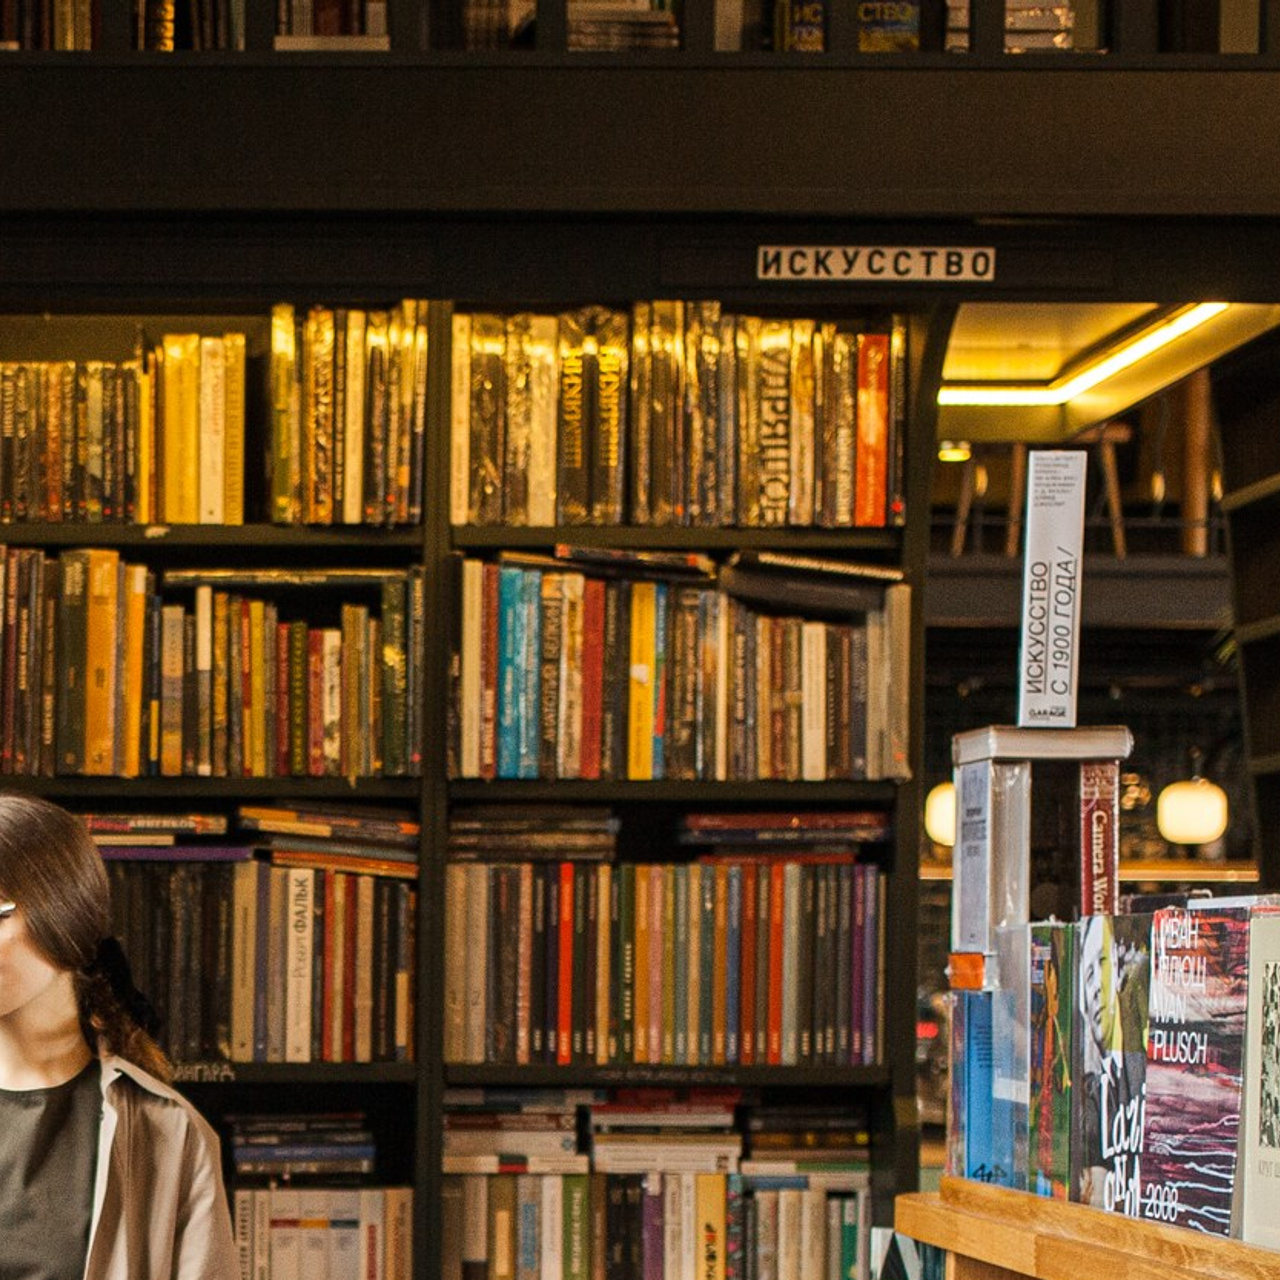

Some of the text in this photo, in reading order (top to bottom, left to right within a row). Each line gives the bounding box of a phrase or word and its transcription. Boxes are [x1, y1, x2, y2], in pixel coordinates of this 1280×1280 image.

[761, 249, 991, 277] ИСКУССТВО
[1026, 561, 1048, 694] ИСКУССТВО
[1053, 625, 1070, 670] 1900
[1051, 680, 1069, 695] С
[1092, 810, 1108, 874] Camera
[292, 877, 309, 934] ФАЛЬК
[1153, 1030, 1208, 1066] PLUSCH
